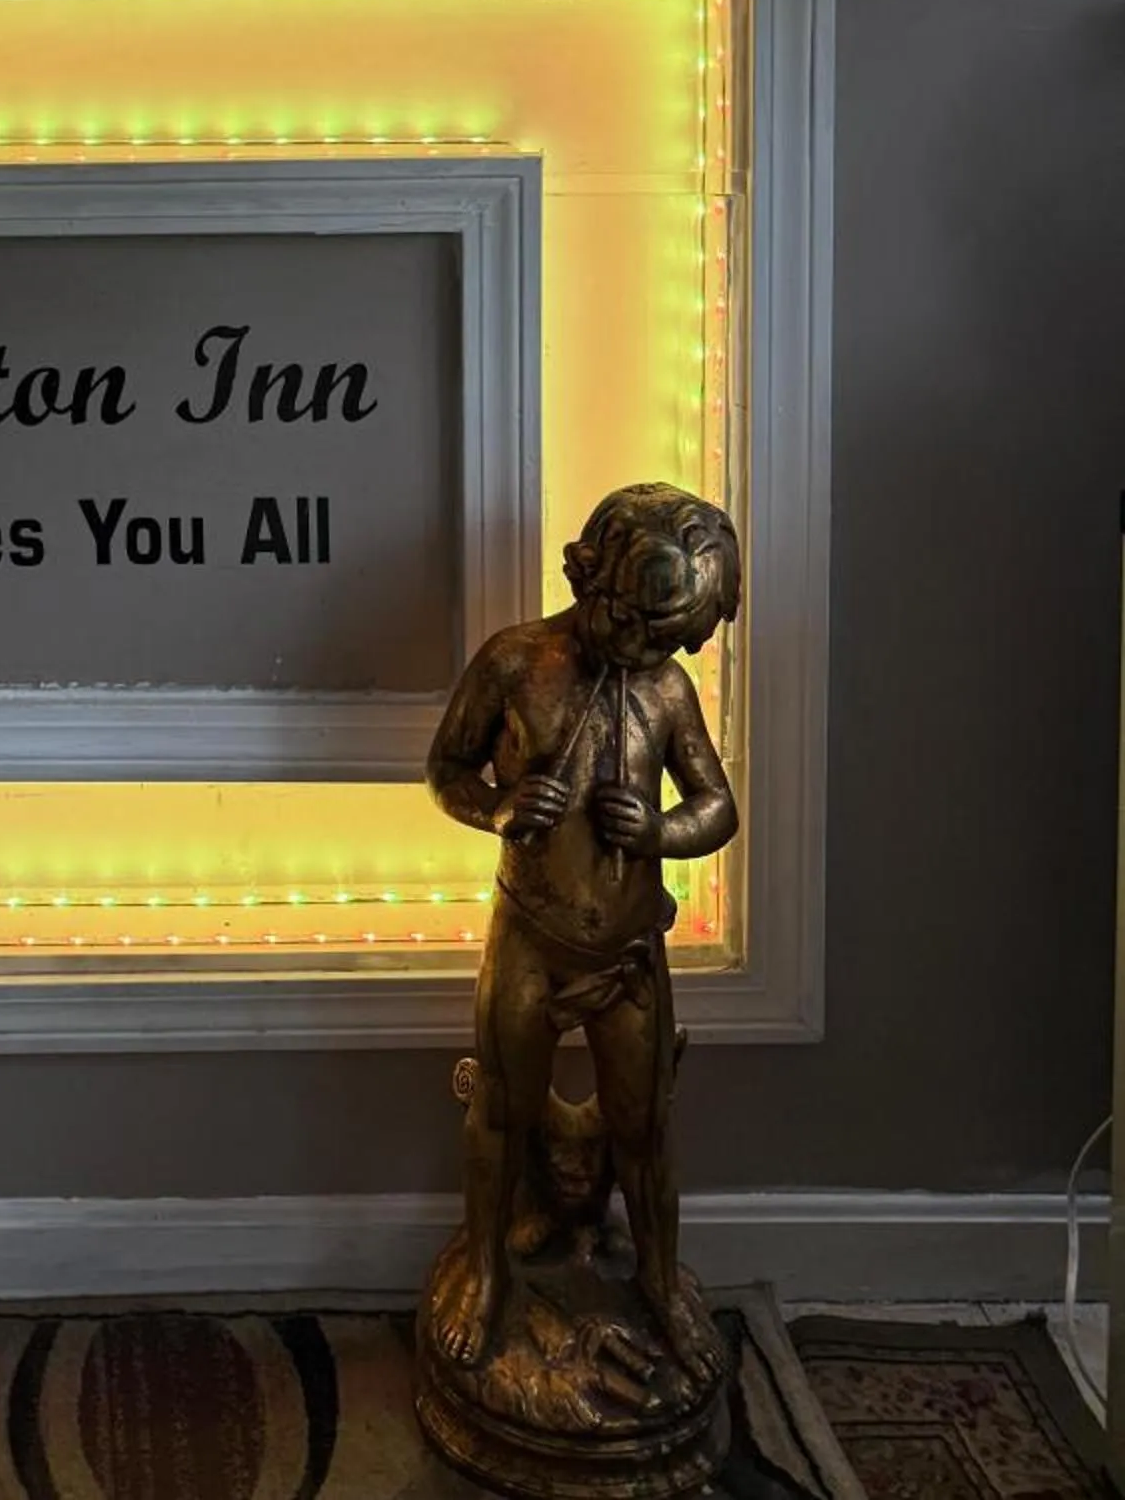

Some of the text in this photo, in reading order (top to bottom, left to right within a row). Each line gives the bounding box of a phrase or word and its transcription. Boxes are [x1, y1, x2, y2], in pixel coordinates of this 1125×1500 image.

[175, 325, 378, 424] Inn
[79, 498, 206, 566] You
[240, 496, 332, 564] All
